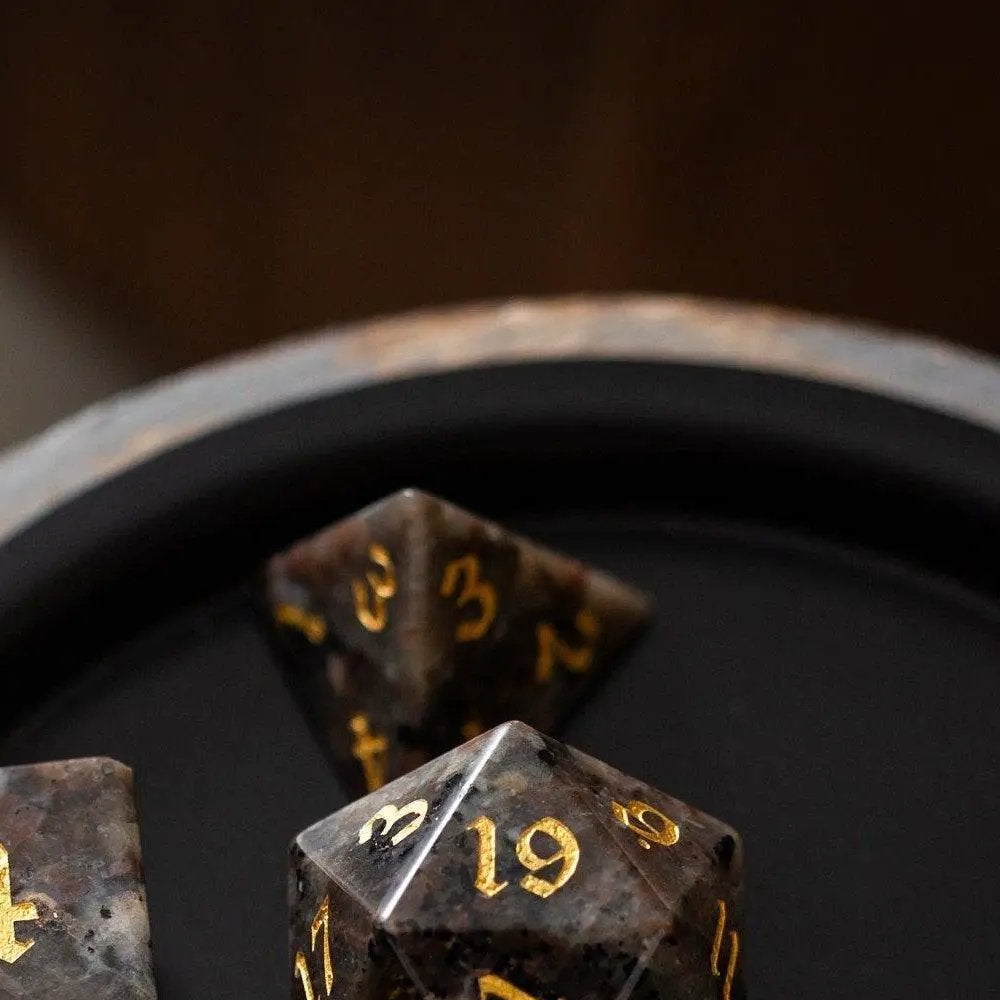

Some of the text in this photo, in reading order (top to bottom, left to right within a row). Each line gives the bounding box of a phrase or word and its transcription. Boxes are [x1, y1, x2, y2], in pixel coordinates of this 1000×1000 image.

[440, 553, 498, 641] 3
[358, 799, 428, 845] 3
[467, 814, 580, 898] 19
